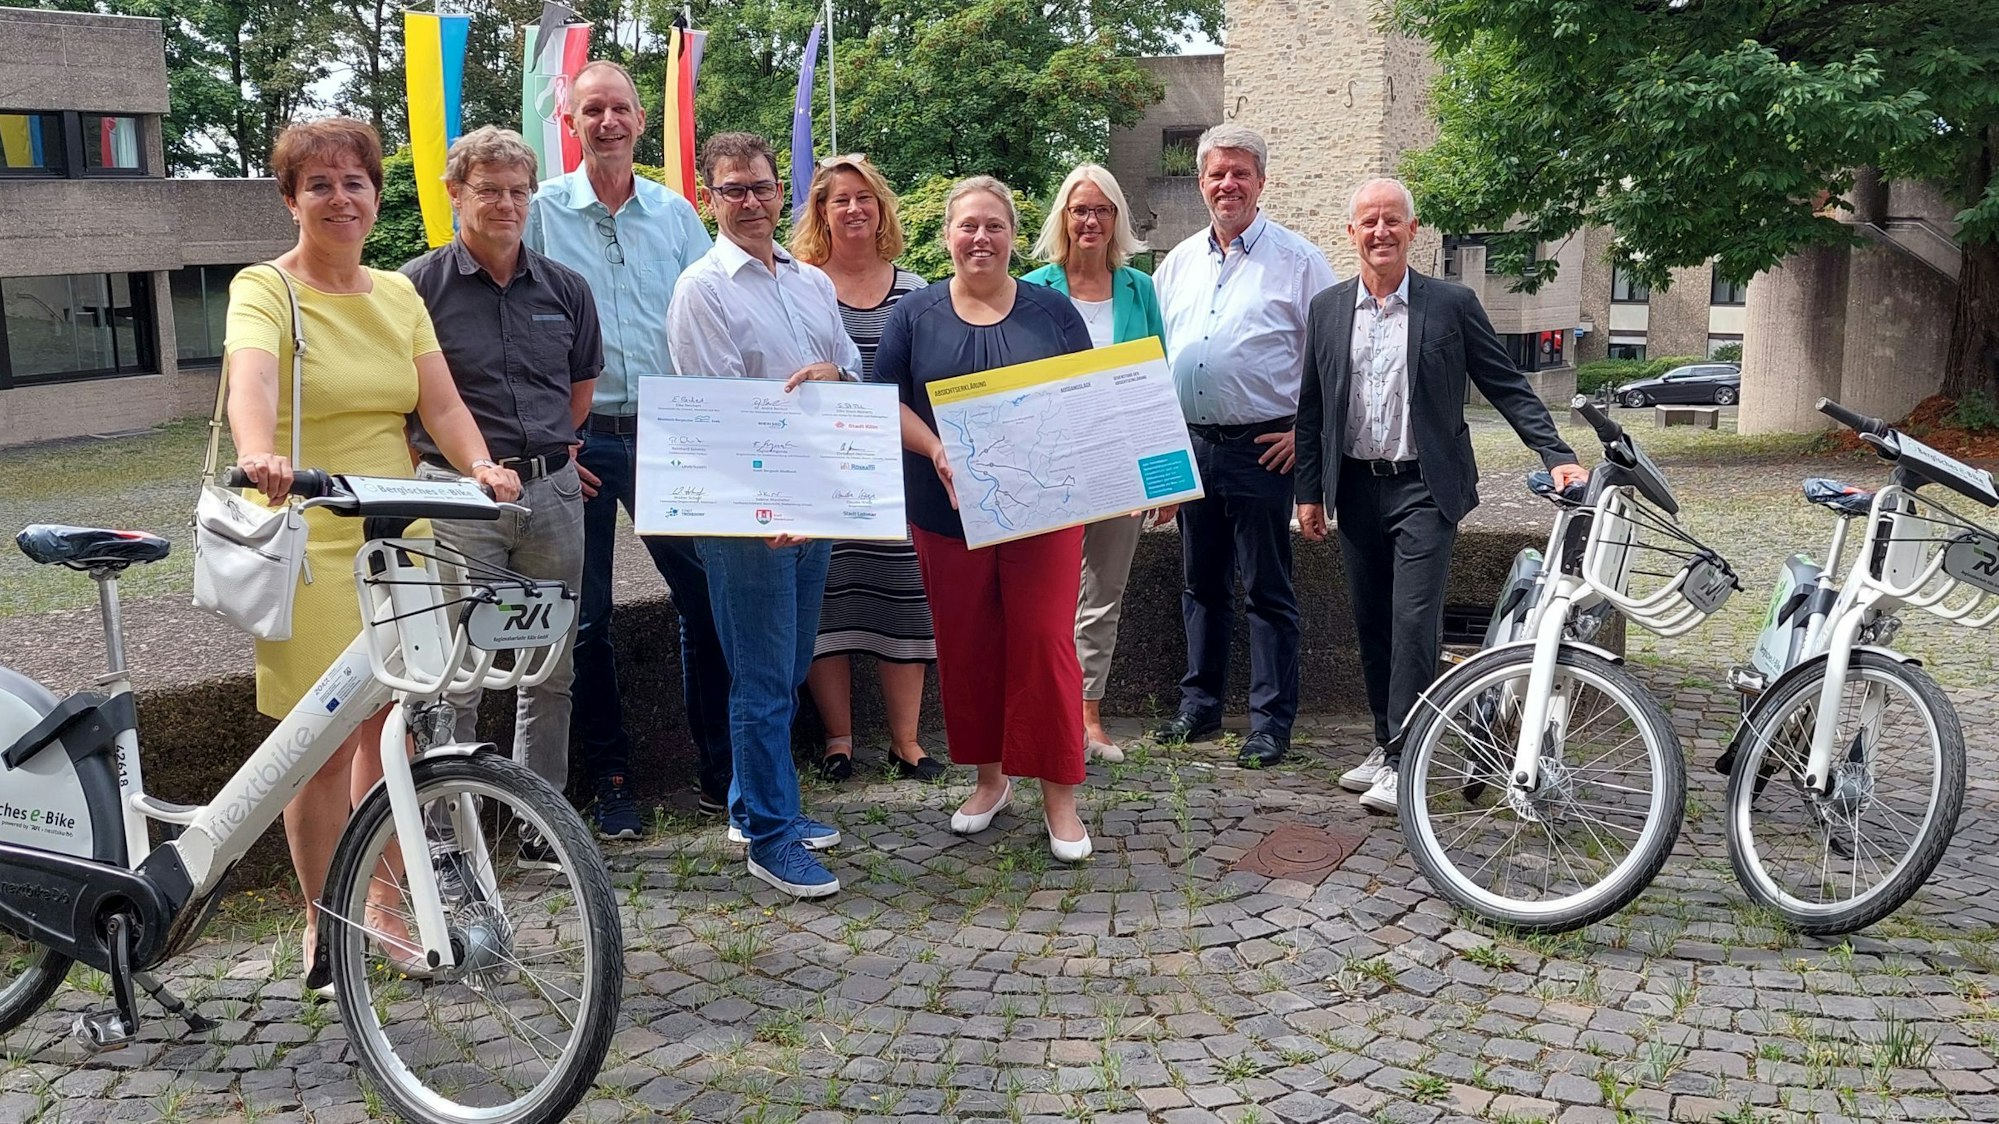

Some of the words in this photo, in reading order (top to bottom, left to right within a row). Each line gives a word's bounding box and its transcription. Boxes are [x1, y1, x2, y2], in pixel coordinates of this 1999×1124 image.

[377, 484, 438, 496] Bergisches
[438, 488, 474, 496] e-Bike
[116, 744, 129, 787] 42618
[209, 726, 315, 842] nextbike
[1, 820, 22, 828] powered
[30, 808, 75, 829] e-Bike
